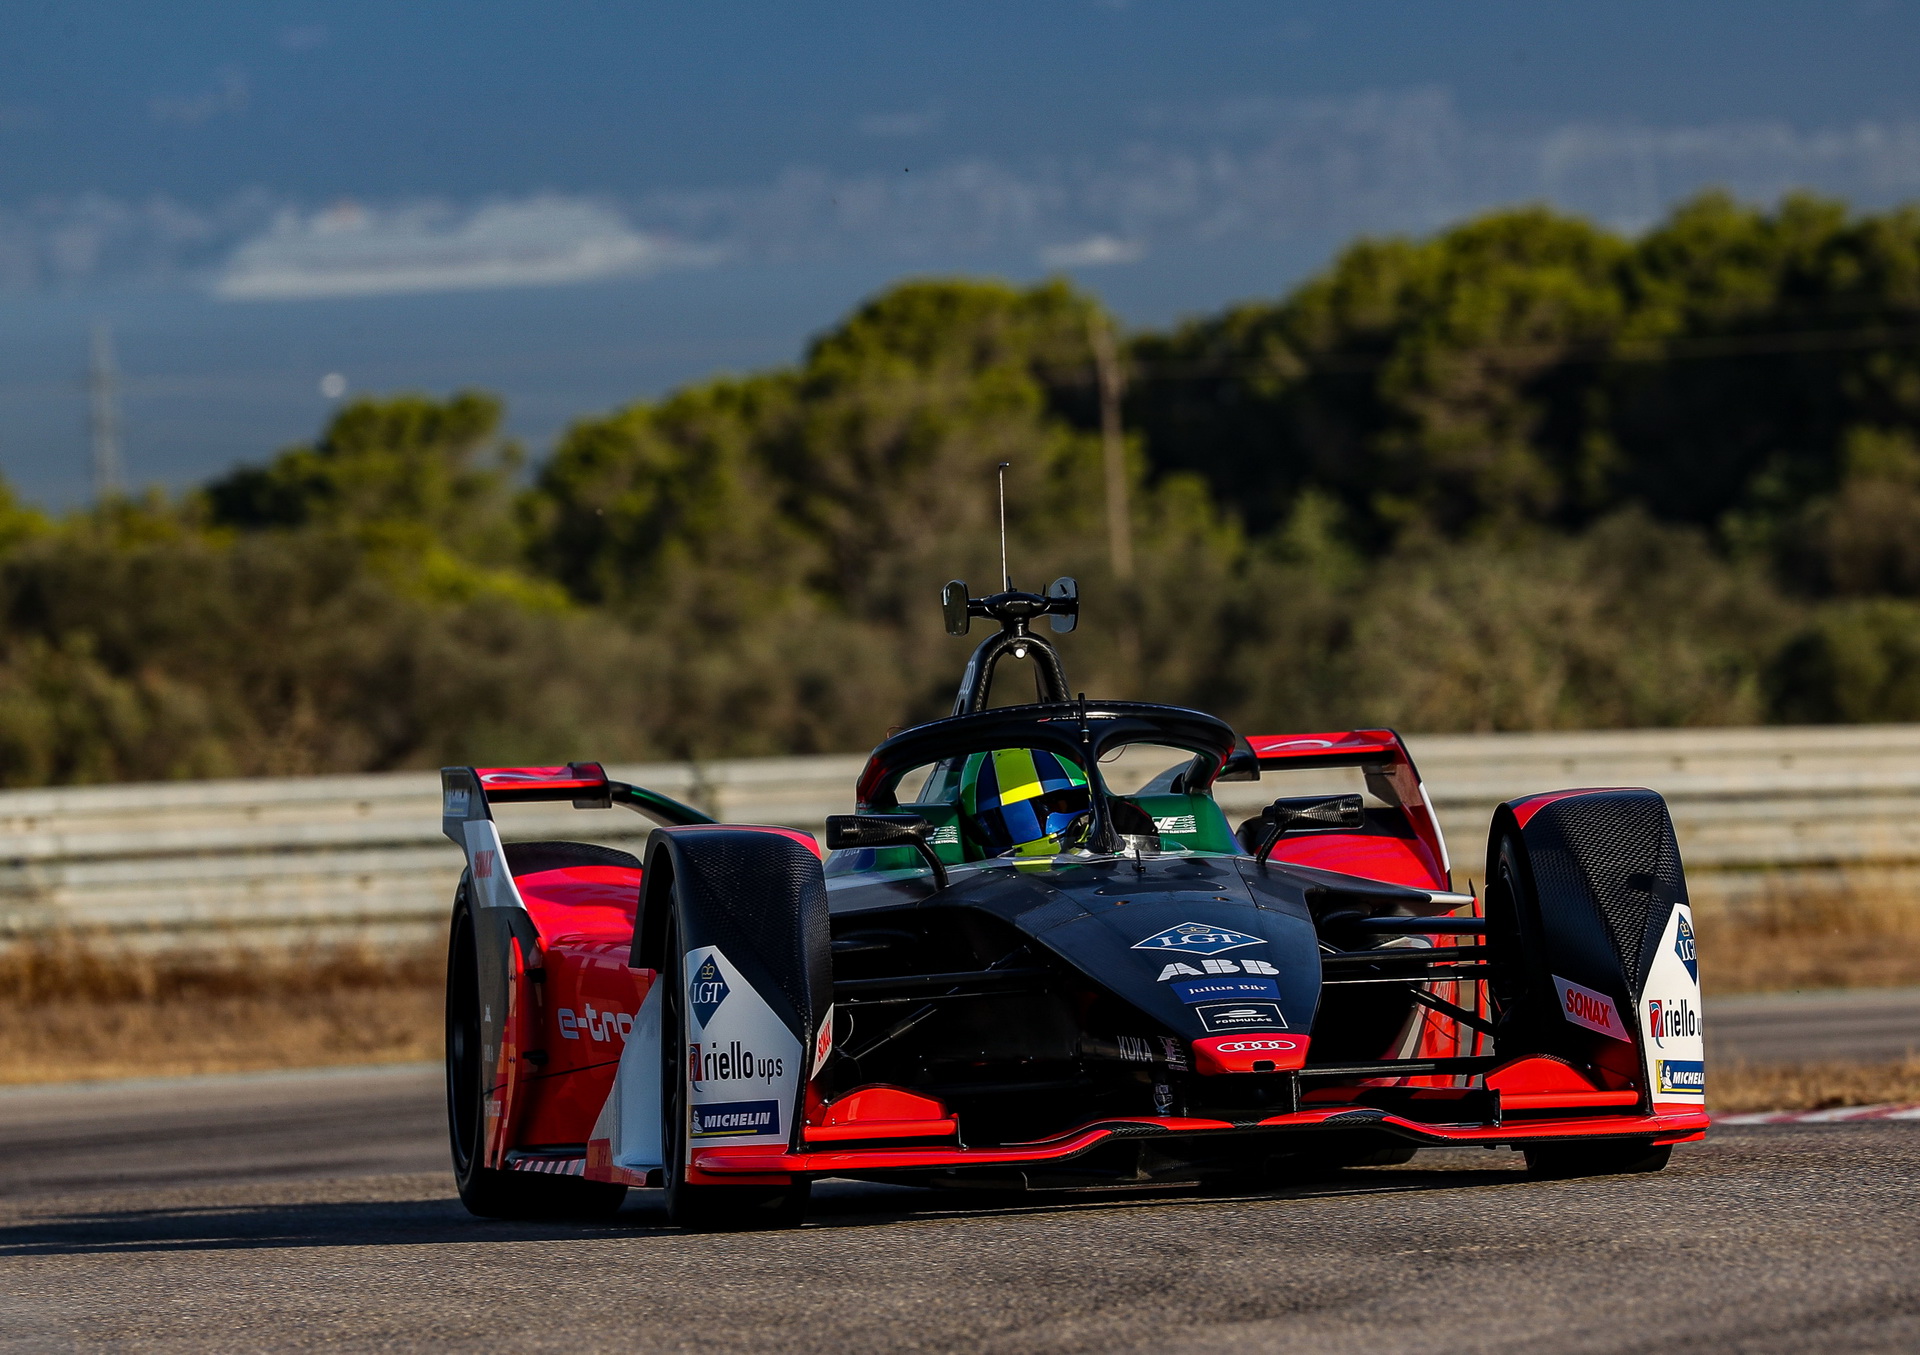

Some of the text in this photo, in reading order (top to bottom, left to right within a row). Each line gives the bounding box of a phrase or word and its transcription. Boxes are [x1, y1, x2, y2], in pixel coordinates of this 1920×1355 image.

[1156, 933, 1242, 948] LGT
[1157, 959, 1280, 982] ABB
[692, 982, 723, 1004] LGT
[1188, 985, 1234, 995] Julius
[1566, 988, 1611, 1029] SONAX
[1665, 998, 1695, 1038] riello
[558, 1003, 637, 1042] e-tro
[1117, 1035, 1153, 1062] KUKA
[704, 1041, 784, 1085] riello ups
[704, 1111, 771, 1128] MICHELIN
